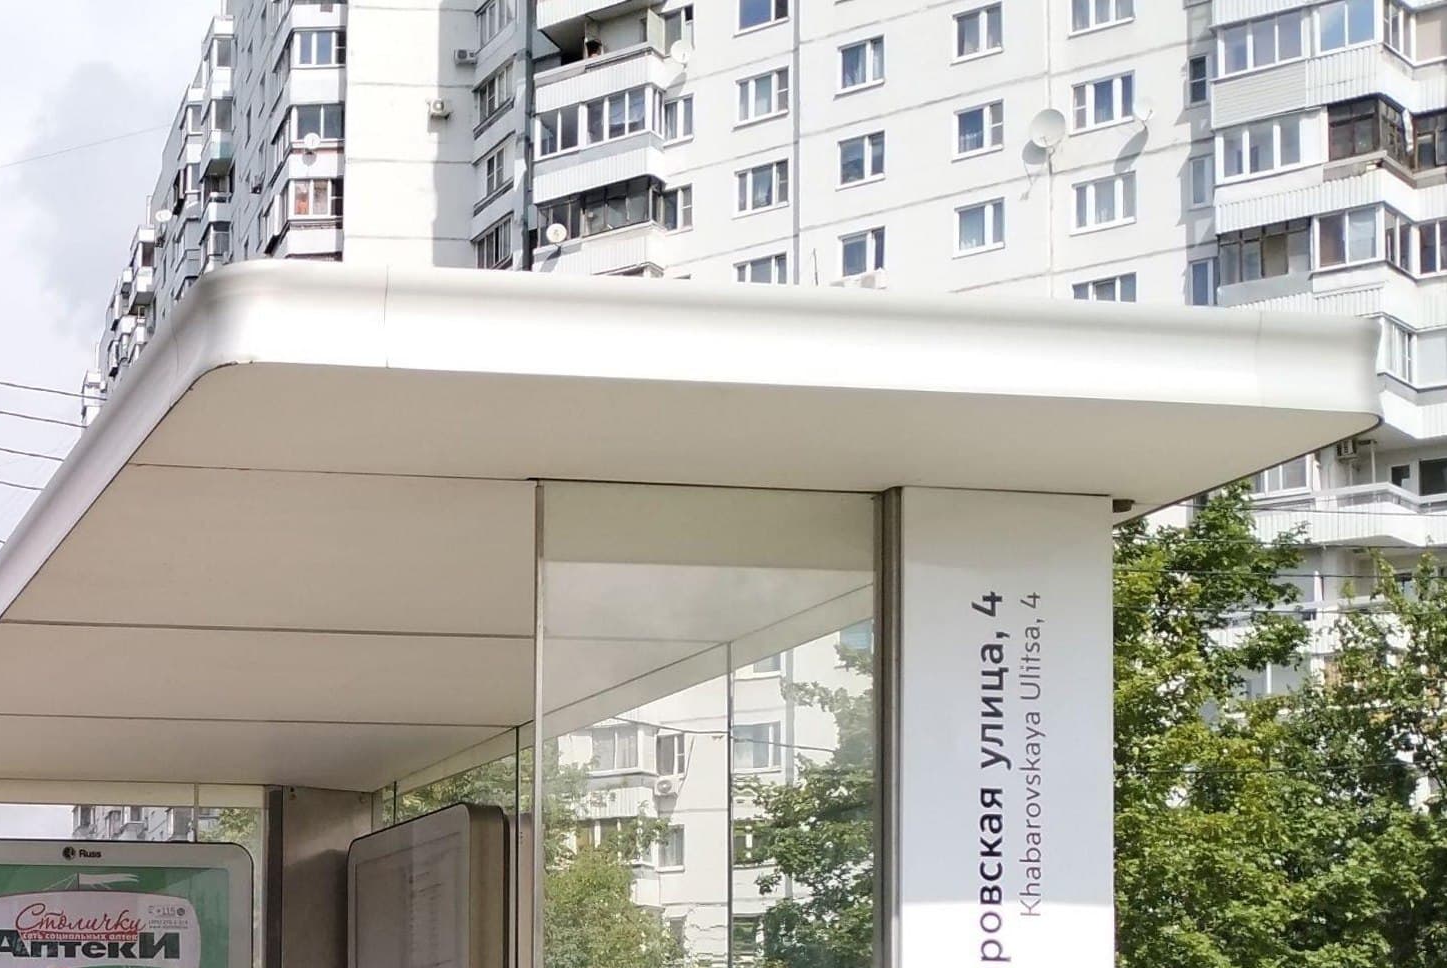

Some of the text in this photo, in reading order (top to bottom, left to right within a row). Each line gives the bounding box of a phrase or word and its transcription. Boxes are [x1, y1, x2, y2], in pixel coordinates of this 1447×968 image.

[971, 590, 1004, 618] 4
[978, 632, 1012, 770] улица,
[1018, 591, 1047, 918] Khabarovskaya Ulitsa, 4
[78, 849, 102, 858] Russ
[15, 902, 147, 932] Столички
